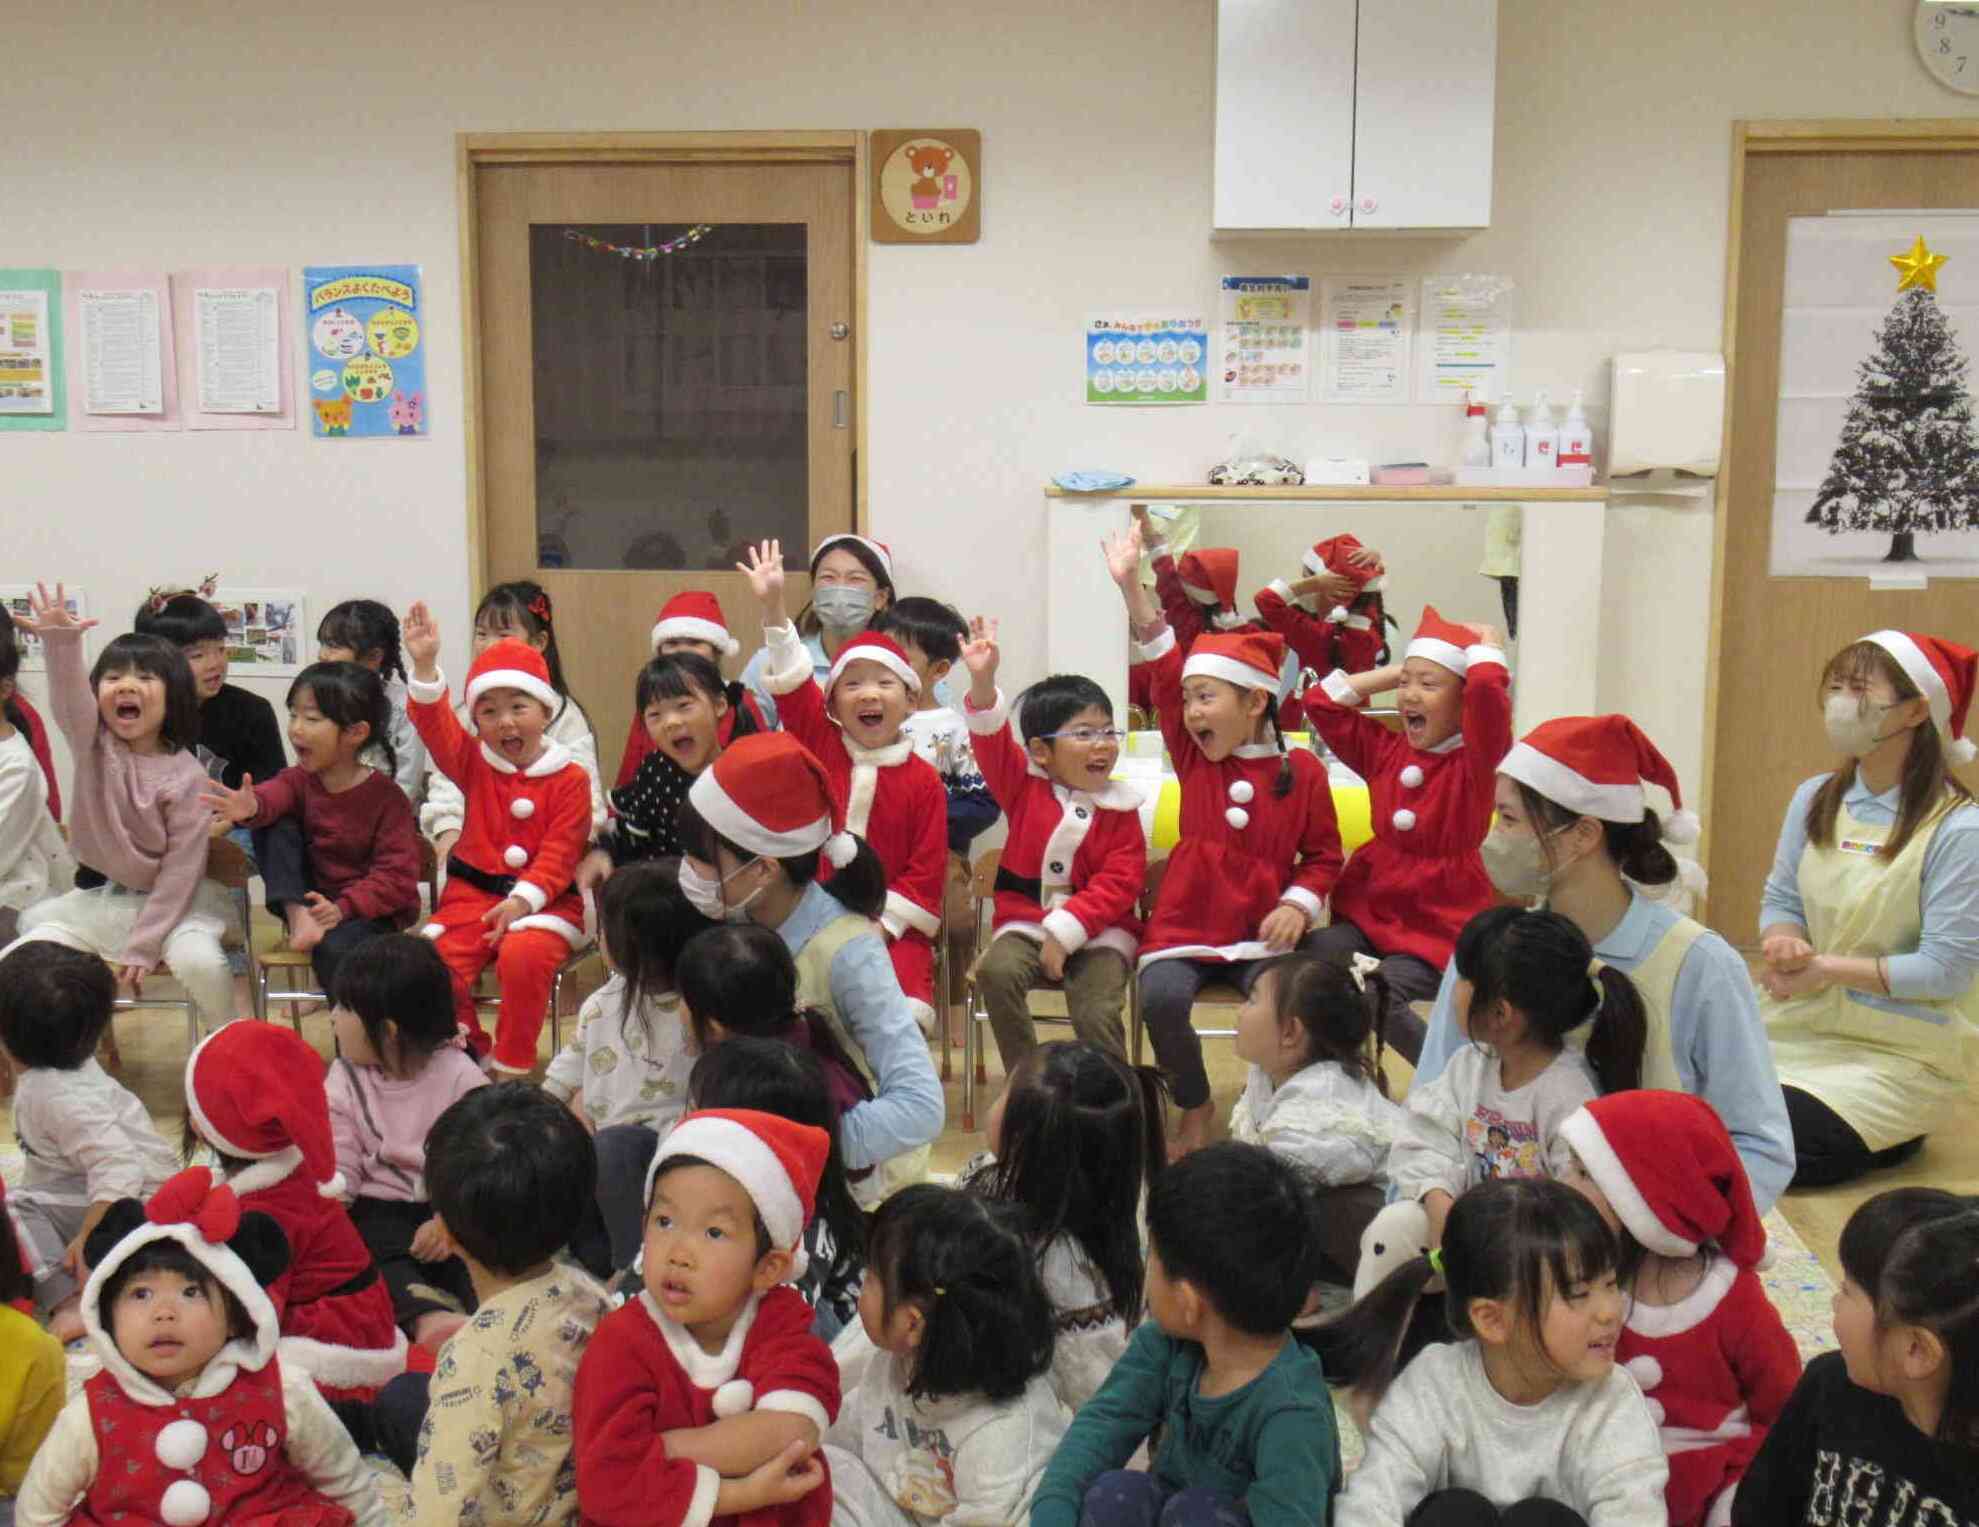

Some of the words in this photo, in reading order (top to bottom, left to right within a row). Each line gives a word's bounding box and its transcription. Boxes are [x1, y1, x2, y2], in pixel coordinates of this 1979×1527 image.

[1939, 36, 1951, 55] 8
[1956, 55, 1968, 73] 7
[905, 210, 951, 224] といれ
